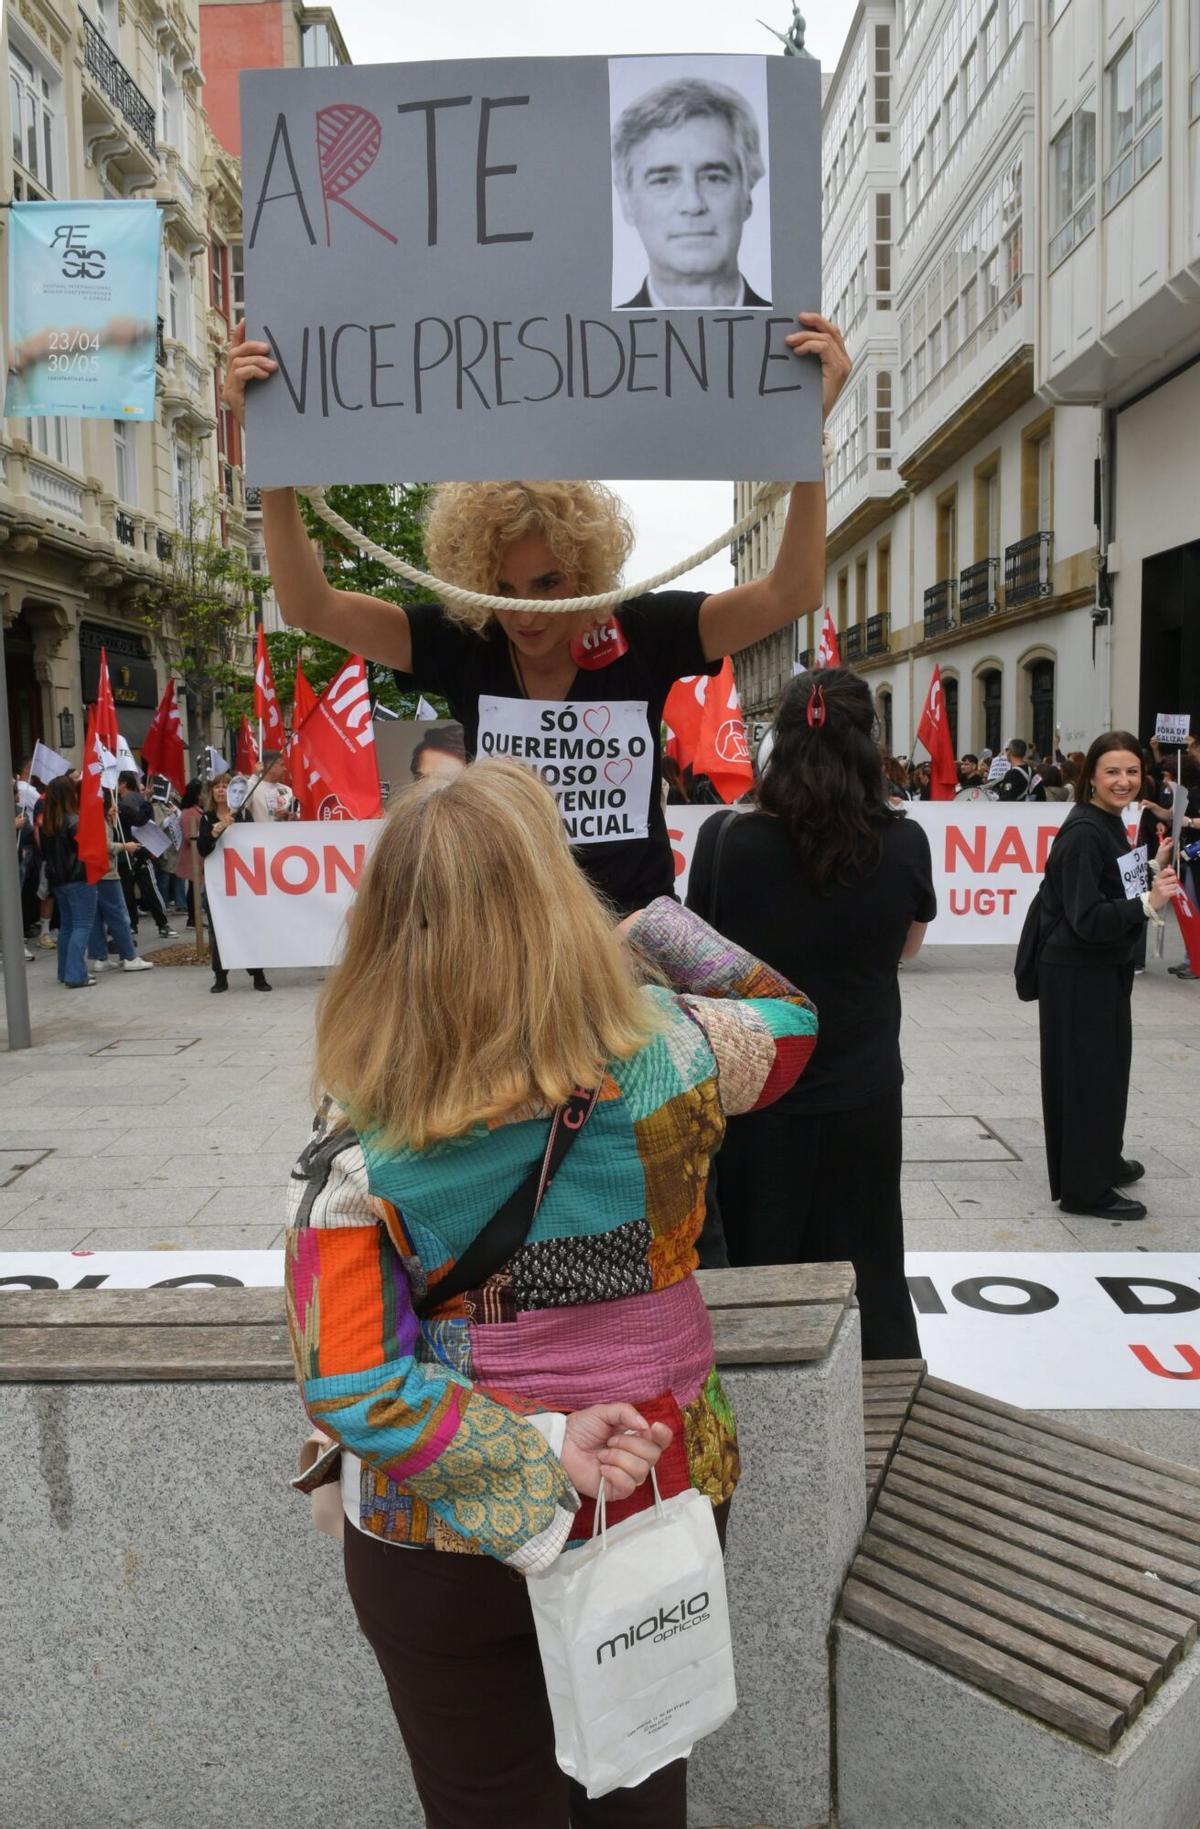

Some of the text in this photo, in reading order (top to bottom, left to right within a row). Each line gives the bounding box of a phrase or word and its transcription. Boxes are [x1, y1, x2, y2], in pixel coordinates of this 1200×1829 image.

[248, 95, 534, 248] ARTE
[48, 329, 100, 352] 23/04
[47, 351, 100, 374] 30/05
[540, 705, 578, 733] SÓ
[481, 731, 646, 760] QUEREMOS O
[563, 813, 635, 839] NCIAL
[223, 844, 365, 897] NON
[949, 888, 1017, 915] UGT
[653, 1612, 711, 1644] opticos
